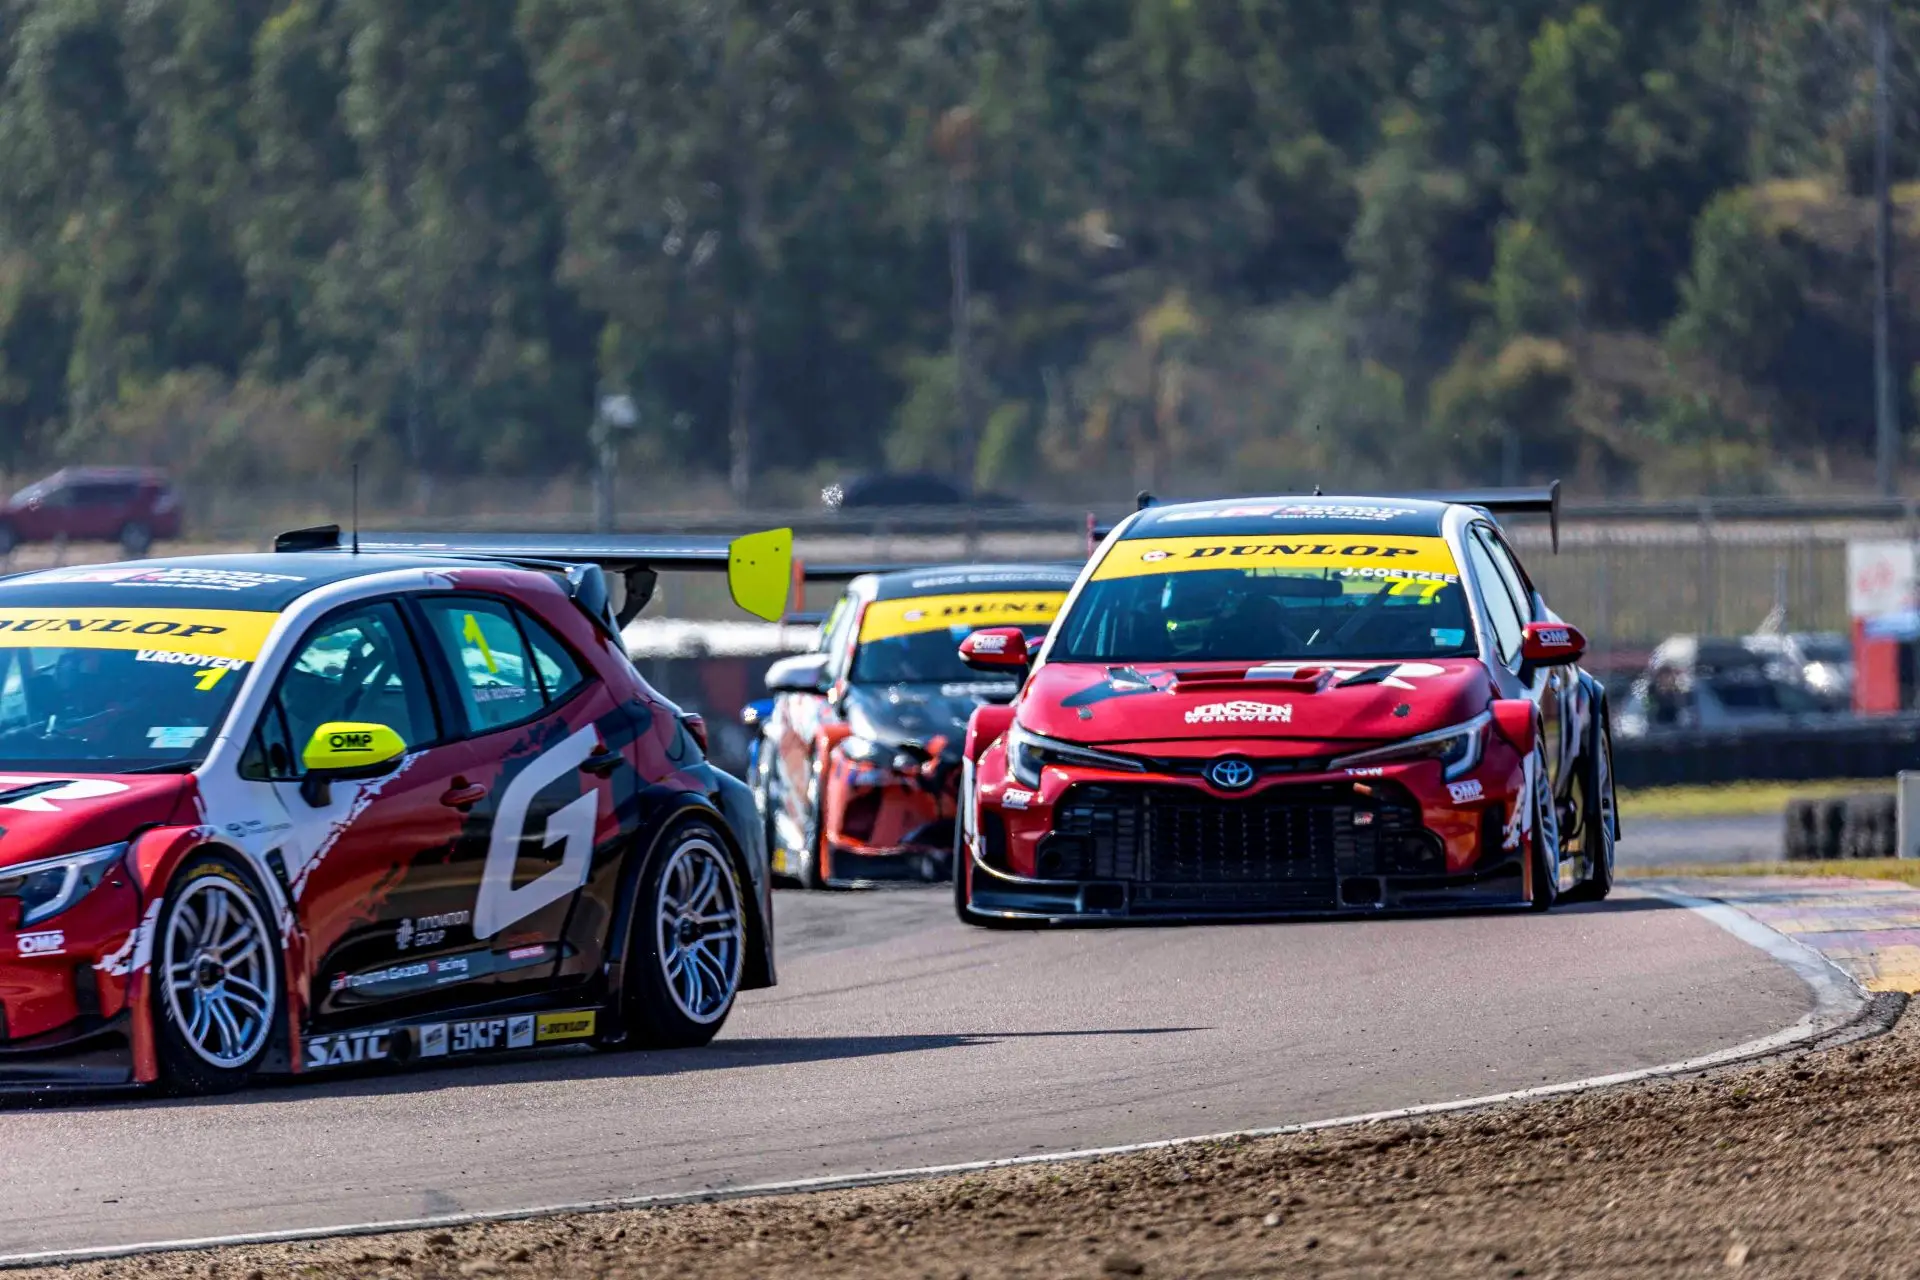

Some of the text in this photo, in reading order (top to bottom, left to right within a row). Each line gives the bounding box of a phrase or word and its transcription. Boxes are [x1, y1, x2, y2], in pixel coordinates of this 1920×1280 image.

[1185, 544, 1419, 558] DUNLOP
[1340, 567, 1459, 583] J.COETZEE
[1384, 576, 1448, 602] 77
[462, 613, 498, 674] 1
[1538, 630, 1570, 645] OMP
[193, 667, 231, 691] 1
[1185, 701, 1292, 718] JONSSON
[1185, 713, 1292, 723] WORKWEAR
[330, 733, 373, 749] OMP
[1345, 767, 1383, 776] TOW
[1450, 781, 1483, 801] OMP
[17, 932, 65, 954] OMP
[453, 1019, 505, 1050] SKF
[308, 1028, 390, 1068] SATC
